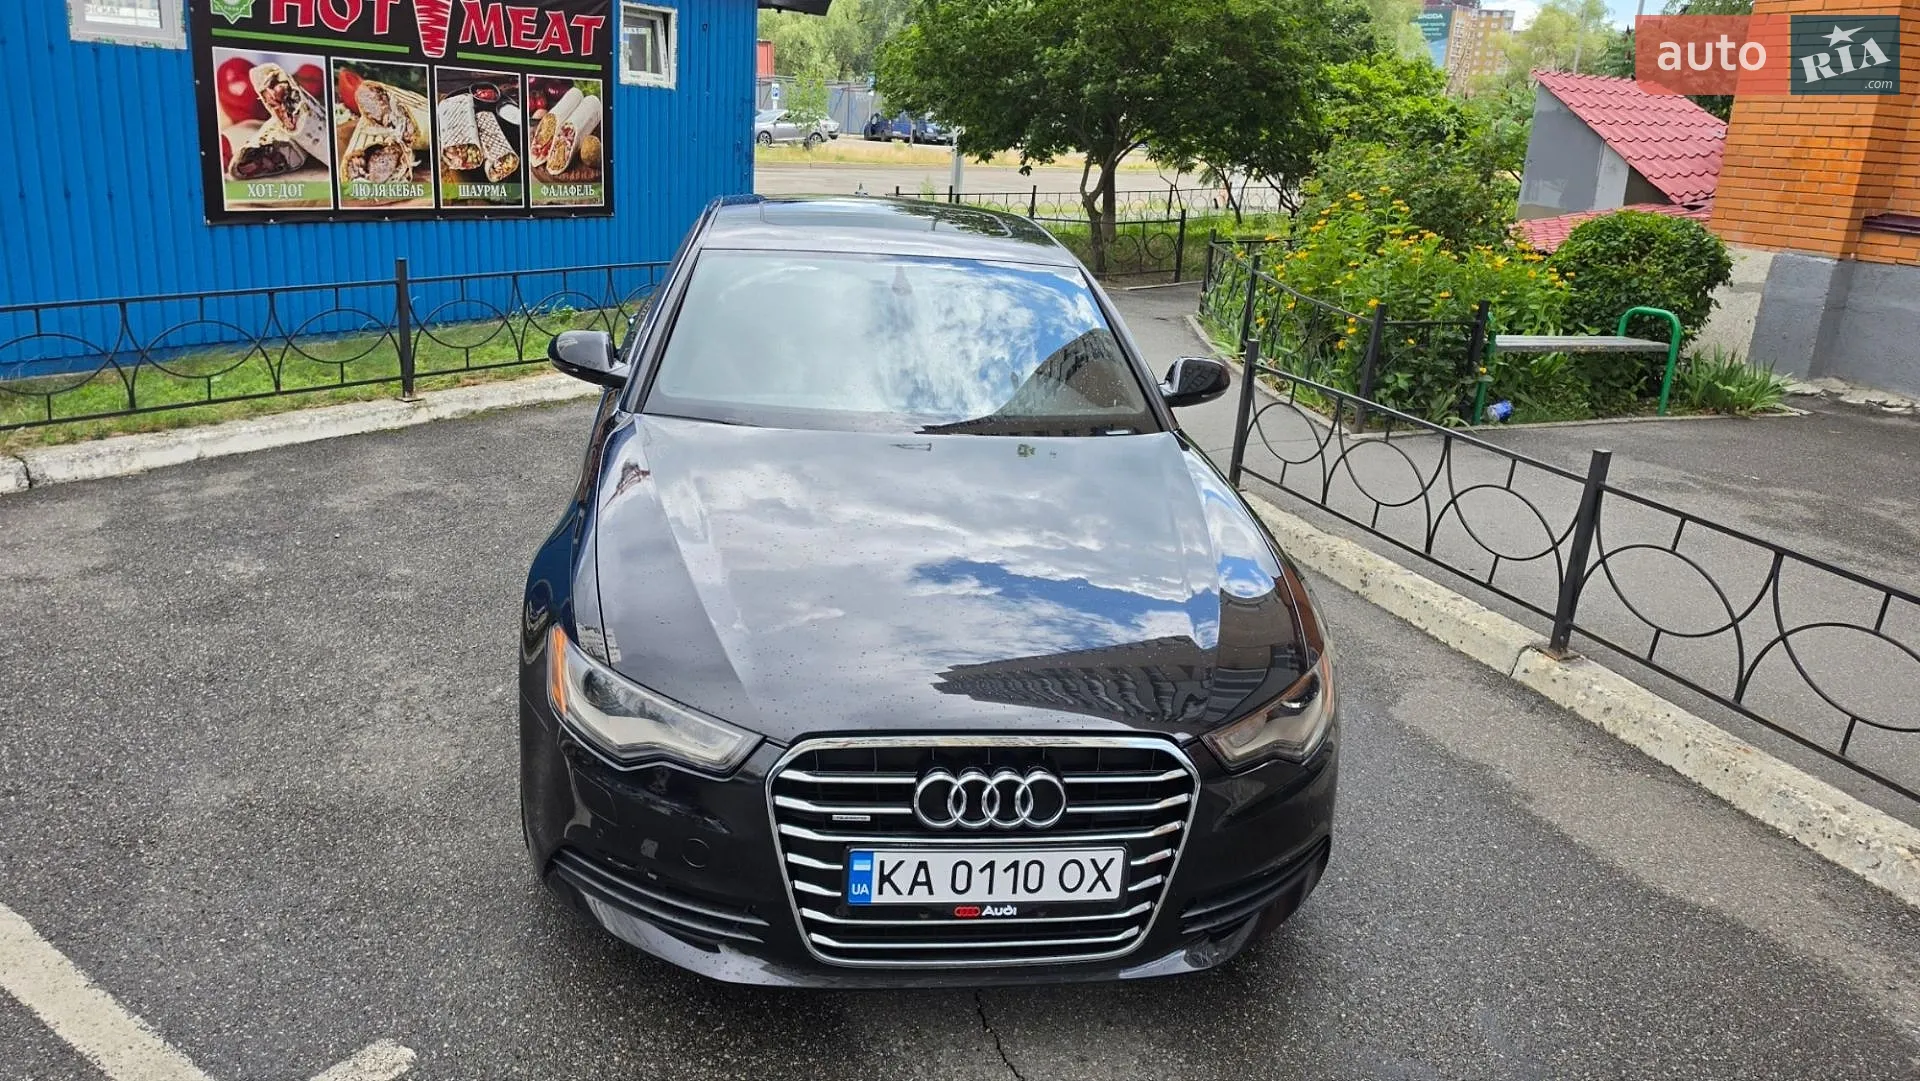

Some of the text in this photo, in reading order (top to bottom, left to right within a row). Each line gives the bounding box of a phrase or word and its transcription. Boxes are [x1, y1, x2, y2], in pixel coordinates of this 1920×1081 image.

[270, 0, 605, 56] HOT MEAT
[247, 183, 305, 198] ХОТ-ДОГ
[350, 183, 424, 198] ЛЮЛЯ КЕБАБ
[458, 184, 507, 198] ШАУРМА
[540, 184, 595, 197] ФАЛАФЕЛЬ
[877, 857, 1116, 896] KA 0110 OX
[852, 883, 870, 897] UA
[982, 905, 1017, 917] Audi
